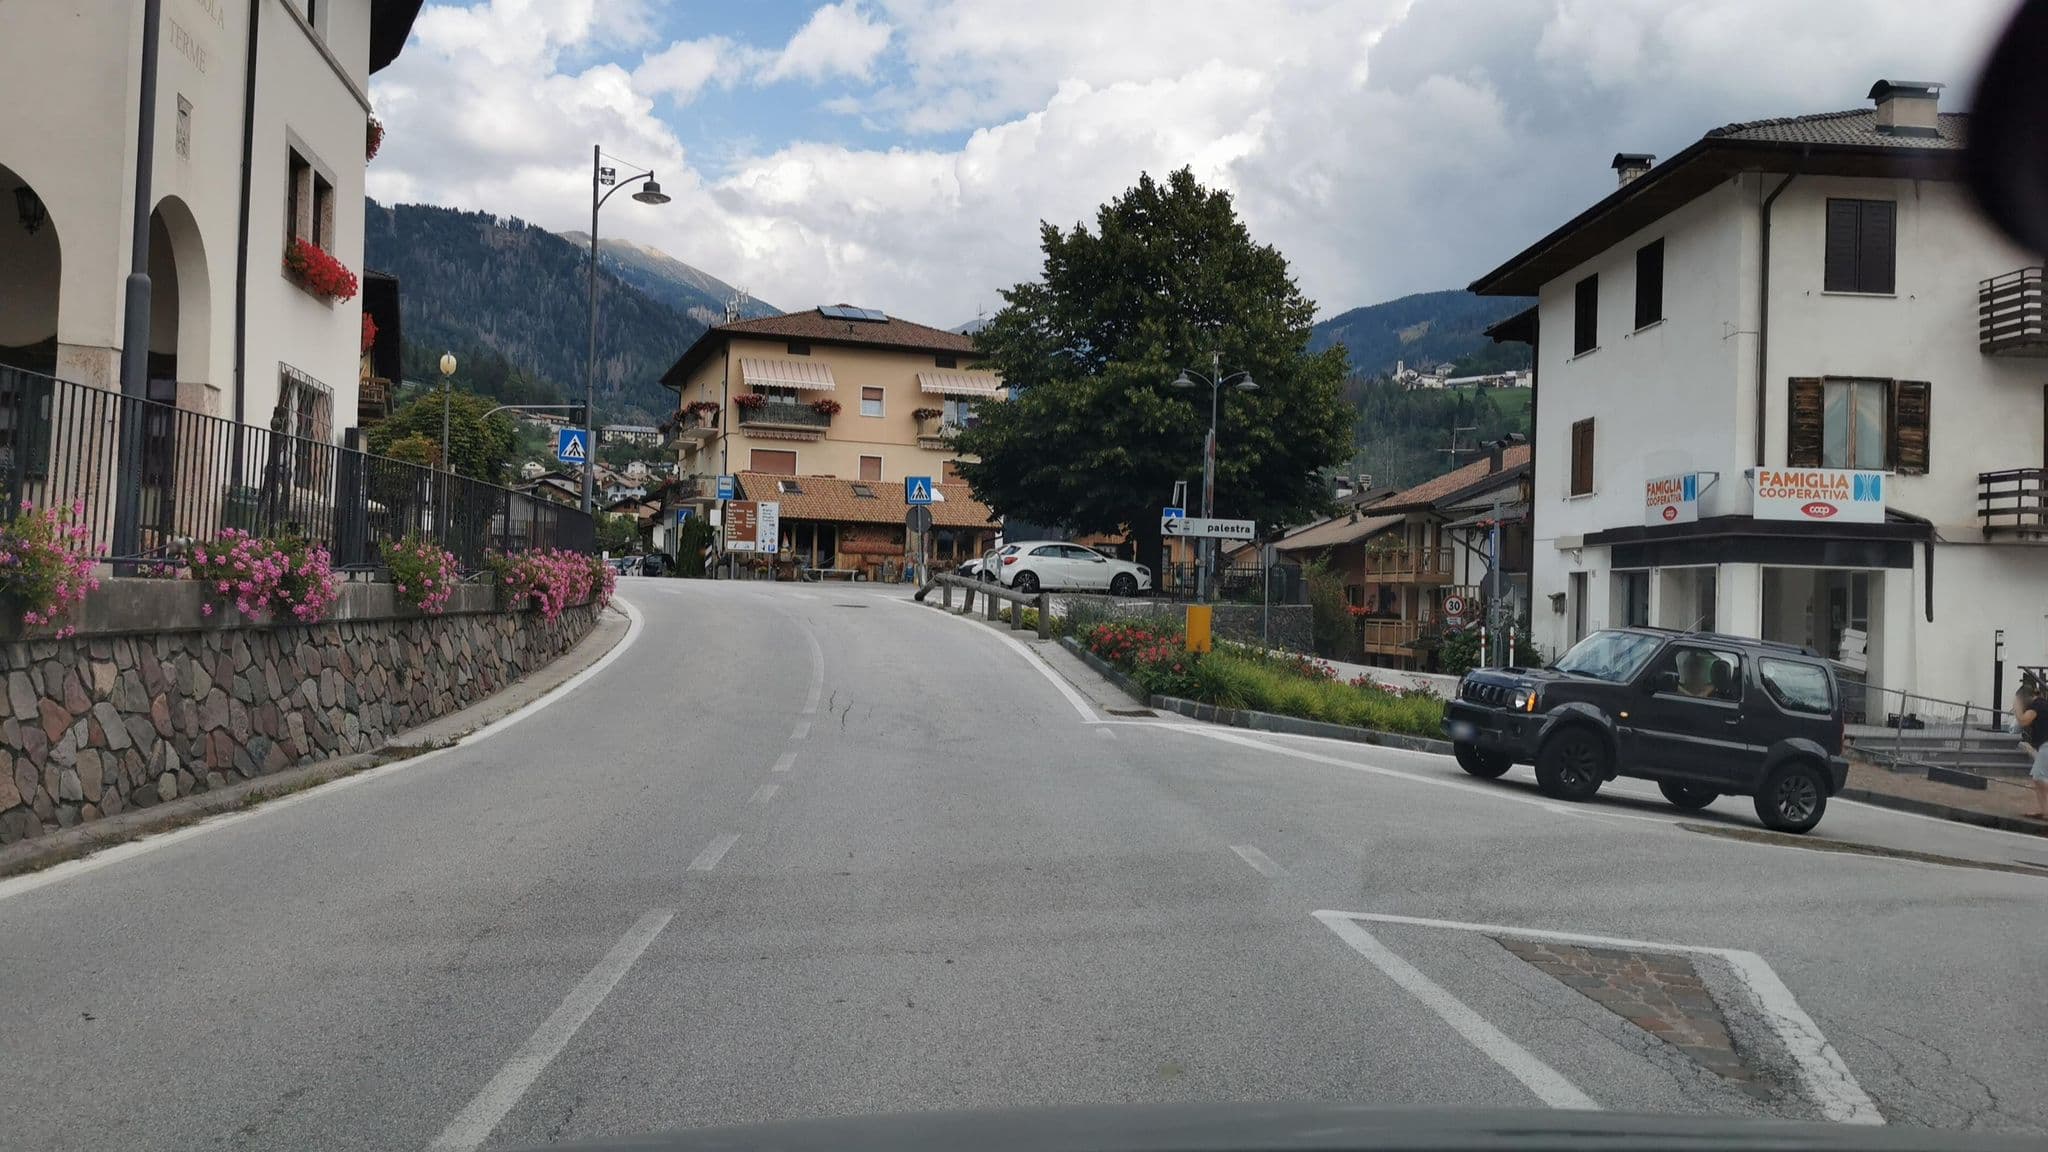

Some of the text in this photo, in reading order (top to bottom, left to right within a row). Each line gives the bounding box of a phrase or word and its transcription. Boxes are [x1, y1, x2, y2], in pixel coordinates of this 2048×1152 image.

[168, 16, 207, 75] TERME
[1647, 478, 1682, 497] FAMIGLIA
[1758, 471, 1849, 490] FAMIGLIA
[1759, 487, 1849, 500] COOPERATIVA
[1207, 523, 1251, 533] palestra
[1448, 600, 1460, 611] 30
